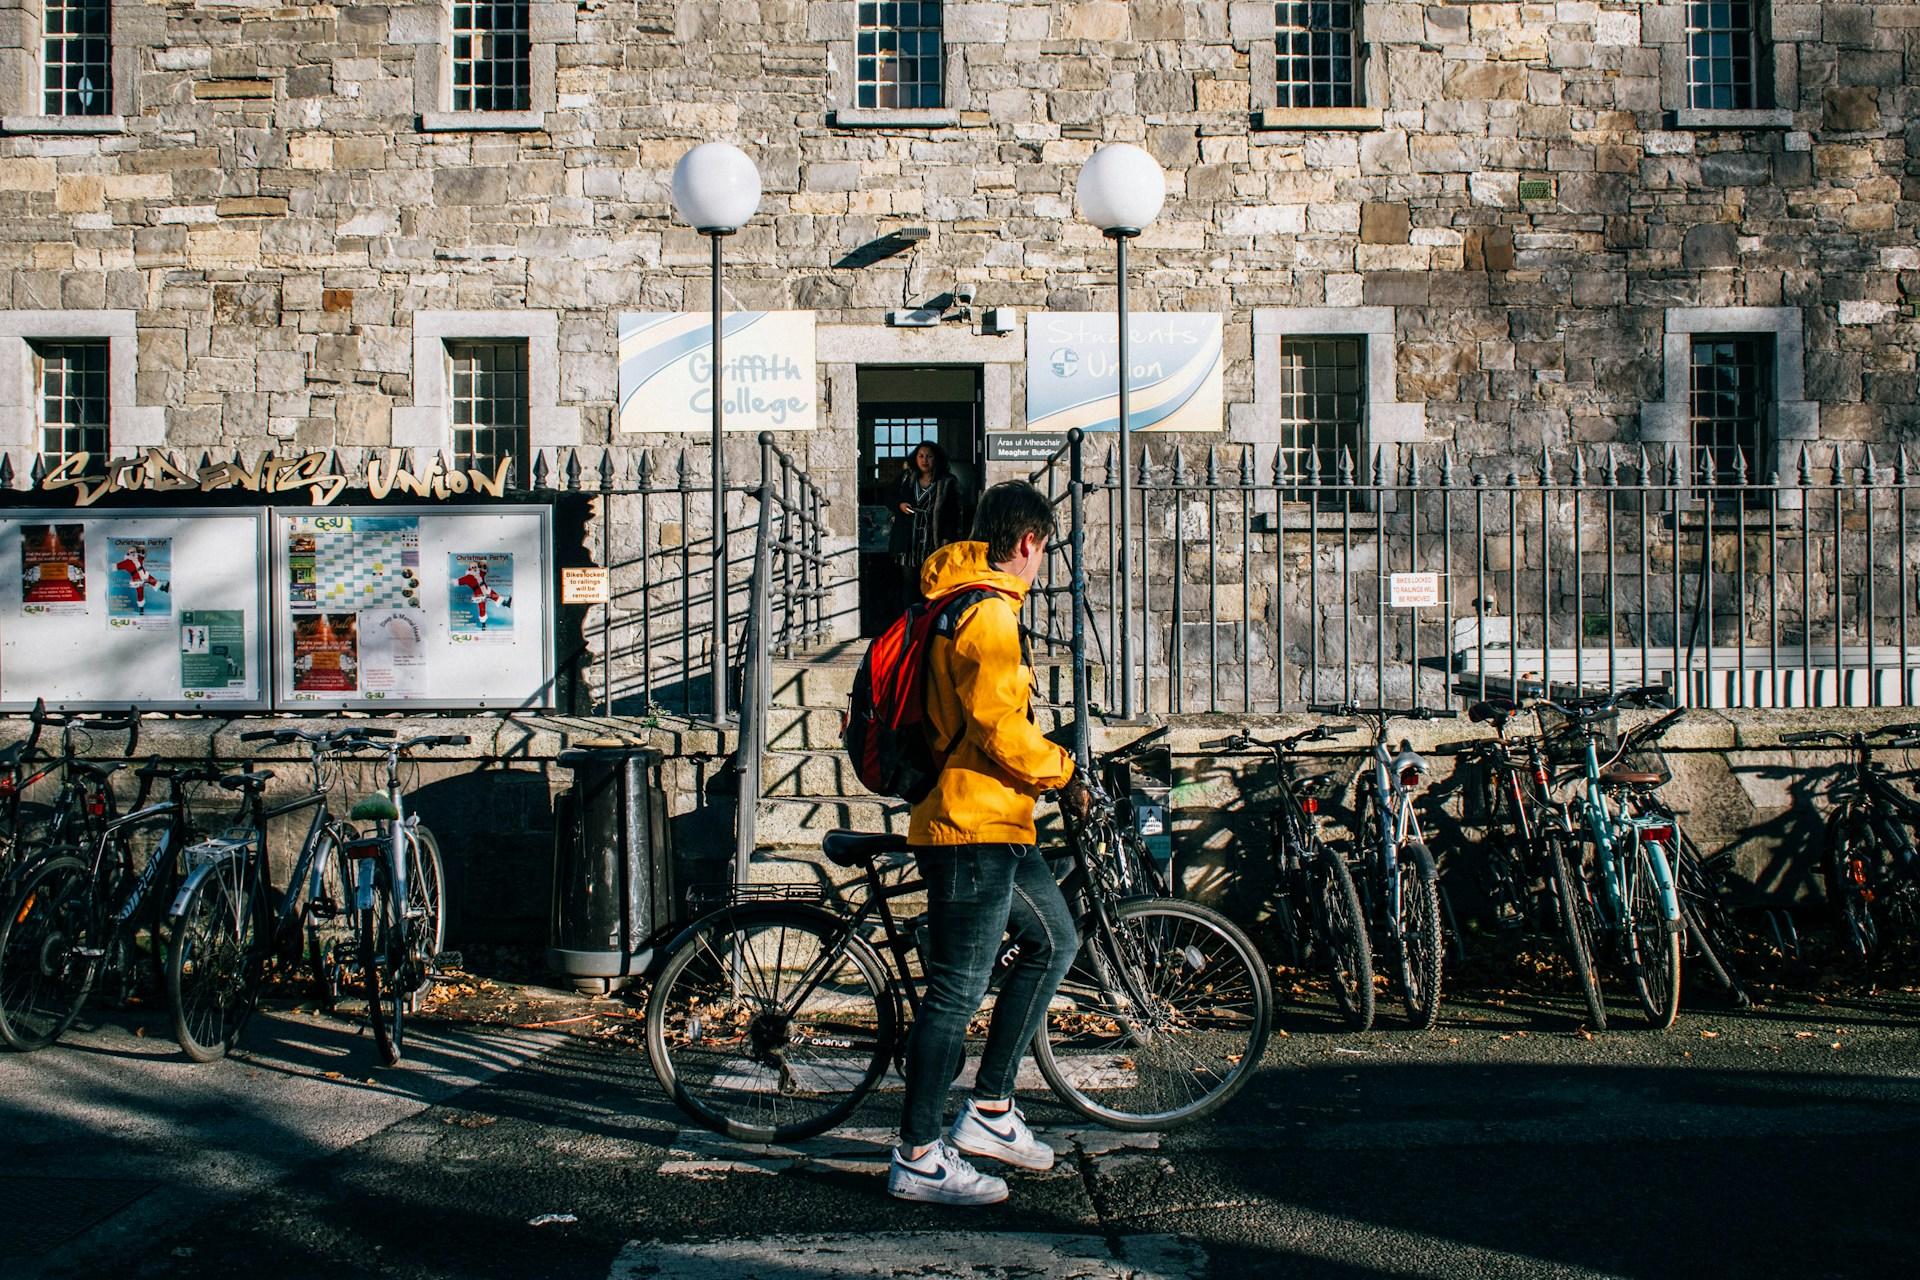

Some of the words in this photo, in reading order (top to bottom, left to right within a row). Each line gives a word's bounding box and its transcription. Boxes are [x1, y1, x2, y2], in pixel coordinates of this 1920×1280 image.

[689, 386, 809, 424] College
[1024, 438, 1060, 446] Mheachair
[998, 449, 1029, 457] Meagher
